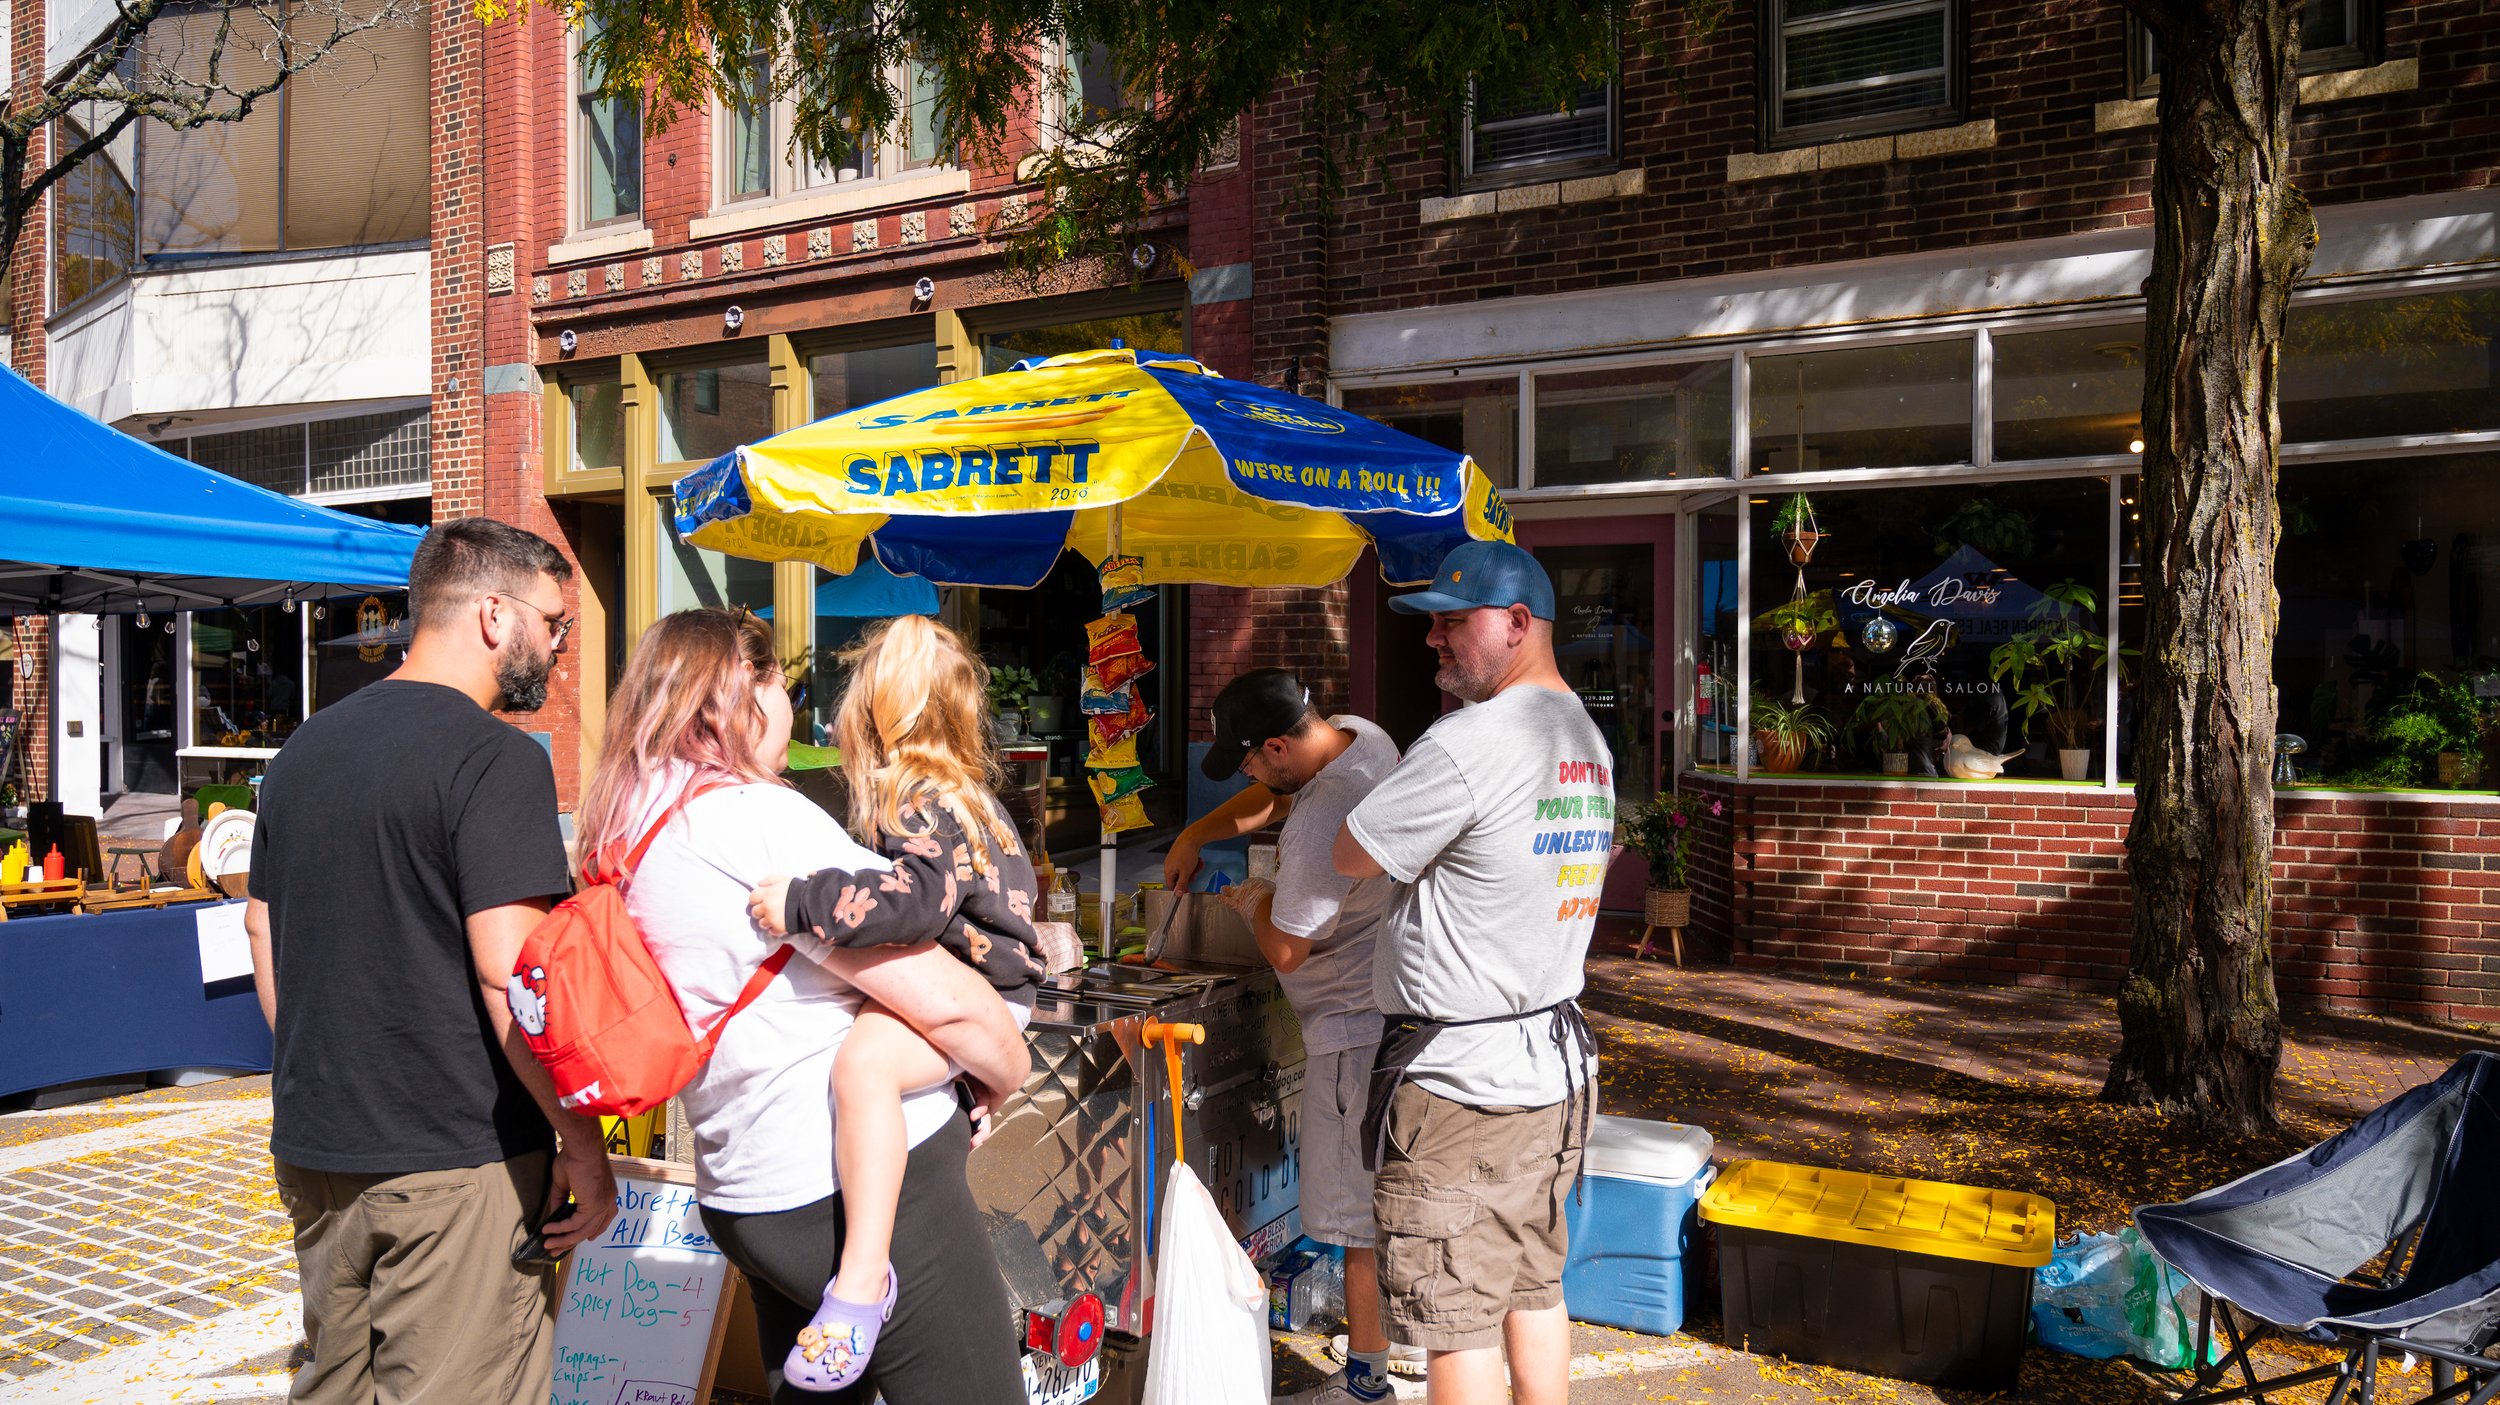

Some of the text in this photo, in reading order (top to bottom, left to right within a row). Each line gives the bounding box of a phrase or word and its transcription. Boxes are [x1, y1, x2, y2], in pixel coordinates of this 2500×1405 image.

[855, 387, 1140, 429] SABRETT
[842, 437, 1100, 497] SABRETT
[1234, 458, 1297, 483] WE'RE
[1300, 467, 1330, 488] ON
[1337, 472, 1351, 490] A
[1359, 471, 1409, 496] ROLL
[1050, 486, 1090, 502] 2016
[1841, 577, 2002, 609] Amelia Davis
[1844, 682, 2001, 694] A NATURAL SALON
[1559, 761, 1594, 785] DON'T
[1534, 795, 1583, 821] YOUR
[1532, 830, 1596, 855] UNLESS
[1209, 1110, 1298, 1186] HOT DO
[1220, 1164, 1271, 1221] COLD
[611, 1217, 649, 1244] All
[1267, 1216, 1286, 1239] BLESS
[576, 1258, 614, 1286] Hot
[623, 1260, 660, 1302] Dog
[621, 1292, 659, 1327] Dog
